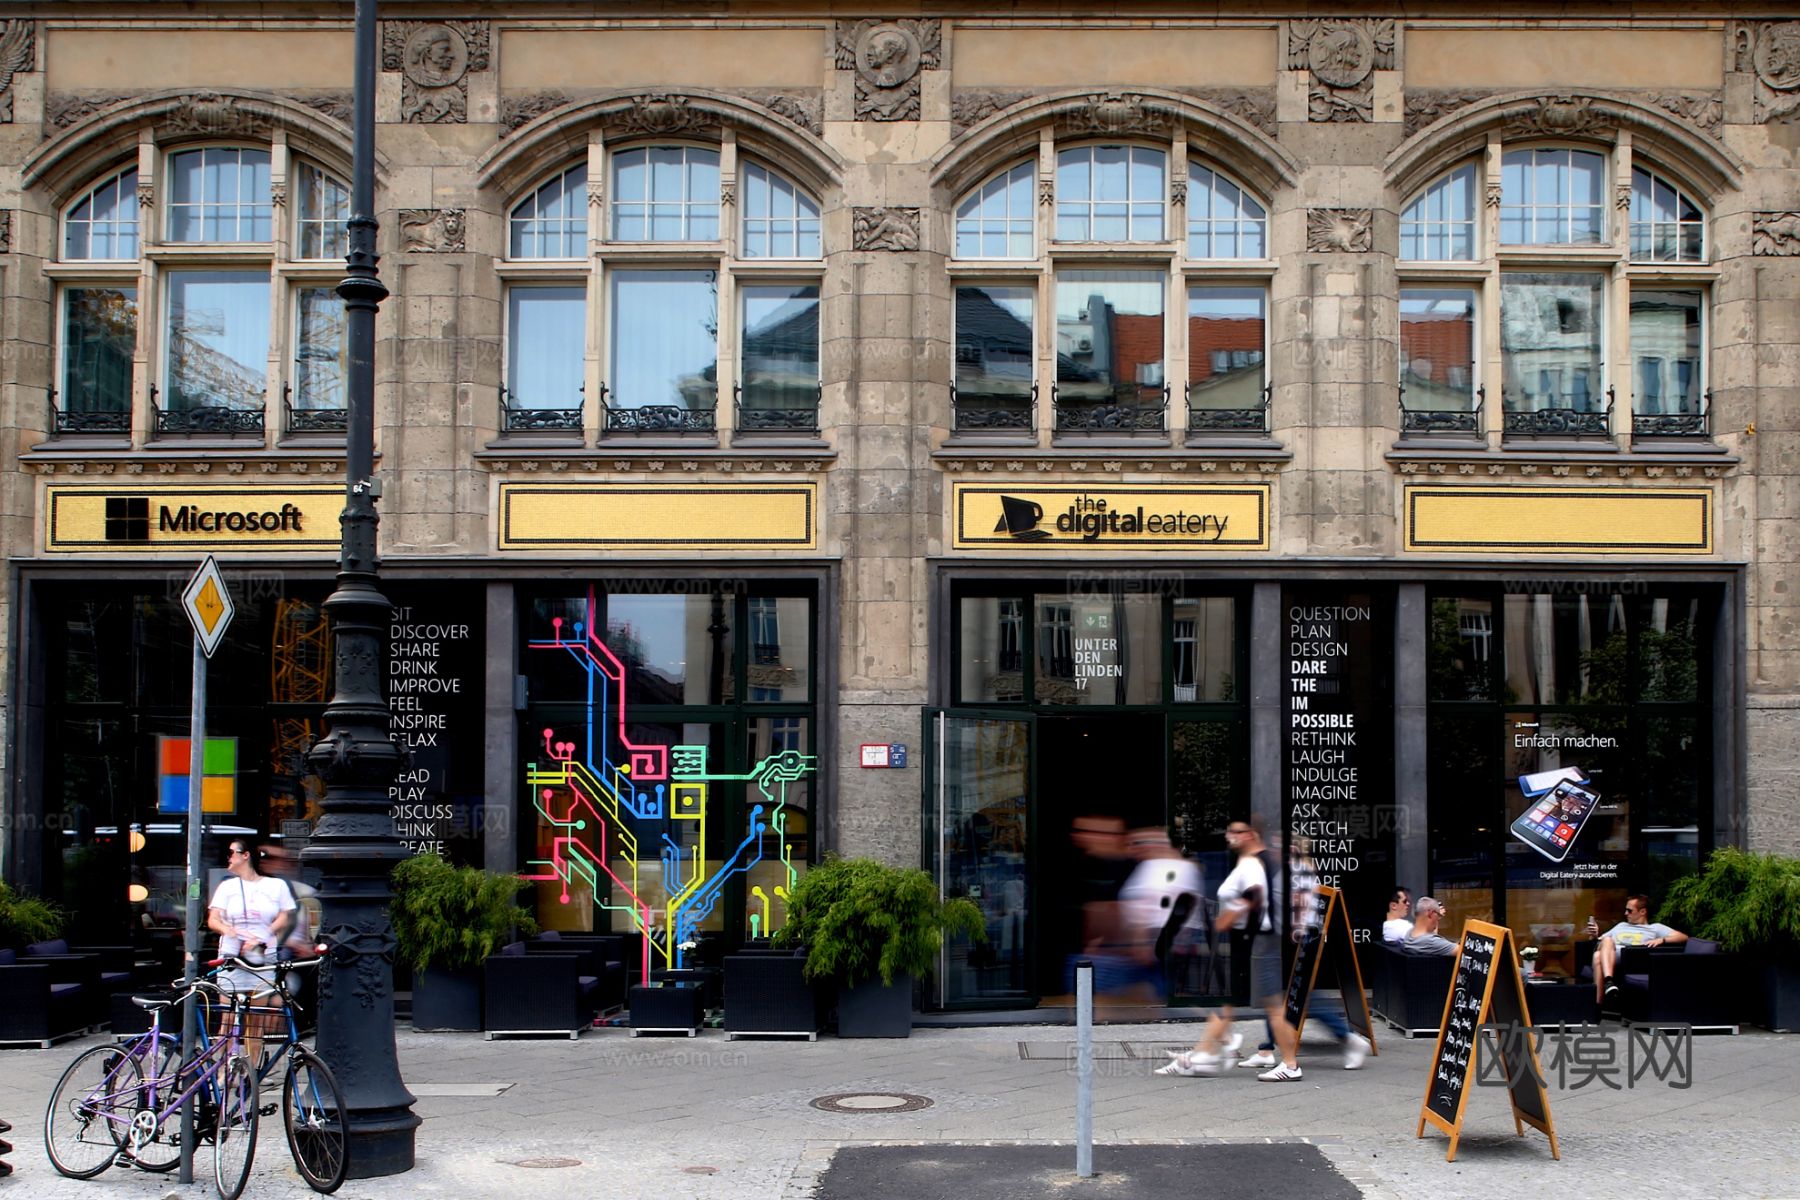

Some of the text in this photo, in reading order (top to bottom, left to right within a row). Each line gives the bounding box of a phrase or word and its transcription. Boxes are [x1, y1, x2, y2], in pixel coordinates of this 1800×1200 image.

[1075, 493, 1107, 512] the
[159, 503, 303, 532] Microsoft
[1056, 506, 1229, 541] digital eatery
[391, 606, 413, 621] SIT
[1289, 606, 1370, 624] QUESTION
[390, 624, 469, 639] DISCOVER
[1291, 624, 1331, 639] PLAN
[390, 642, 440, 657] SHARE
[1075, 638, 1117, 651] UNTER
[1291, 642, 1348, 657] DESIGN
[1075, 651, 1100, 664] DEN
[390, 660, 438, 675] DRINK
[1075, 664, 1123, 677] LINDEN
[1291, 660, 1327, 674] DARE
[390, 678, 460, 693] IMPROVE
[1074, 678, 1088, 690] 17
[1291, 678, 1317, 692] THE
[389, 696, 423, 711] FEEL
[1291, 696, 1308, 710] IM
[389, 714, 447, 729] INSPIRE
[1291, 714, 1354, 728] POSSIBLE
[1291, 731, 1357, 746] RETHINK
[1514, 733, 1619, 748] Einfach machen.
[1291, 749, 1345, 764] LAUGH
[394, 768, 430, 783] EAD
[1291, 767, 1358, 782] INDULGE
[388, 787, 426, 801] PLAY
[1291, 785, 1357, 800] IMAGINE
[1291, 803, 1321, 818] ASK
[397, 823, 436, 837] HINK
[1291, 821, 1348, 836] SKETCH
[1291, 839, 1355, 854] RETREAT
[1291, 857, 1359, 872] UNWIND
[1291, 875, 1341, 890] SHAPE
[1540, 871, 1558, 880] Digital
[1559, 871, 1578, 880] Eatery
